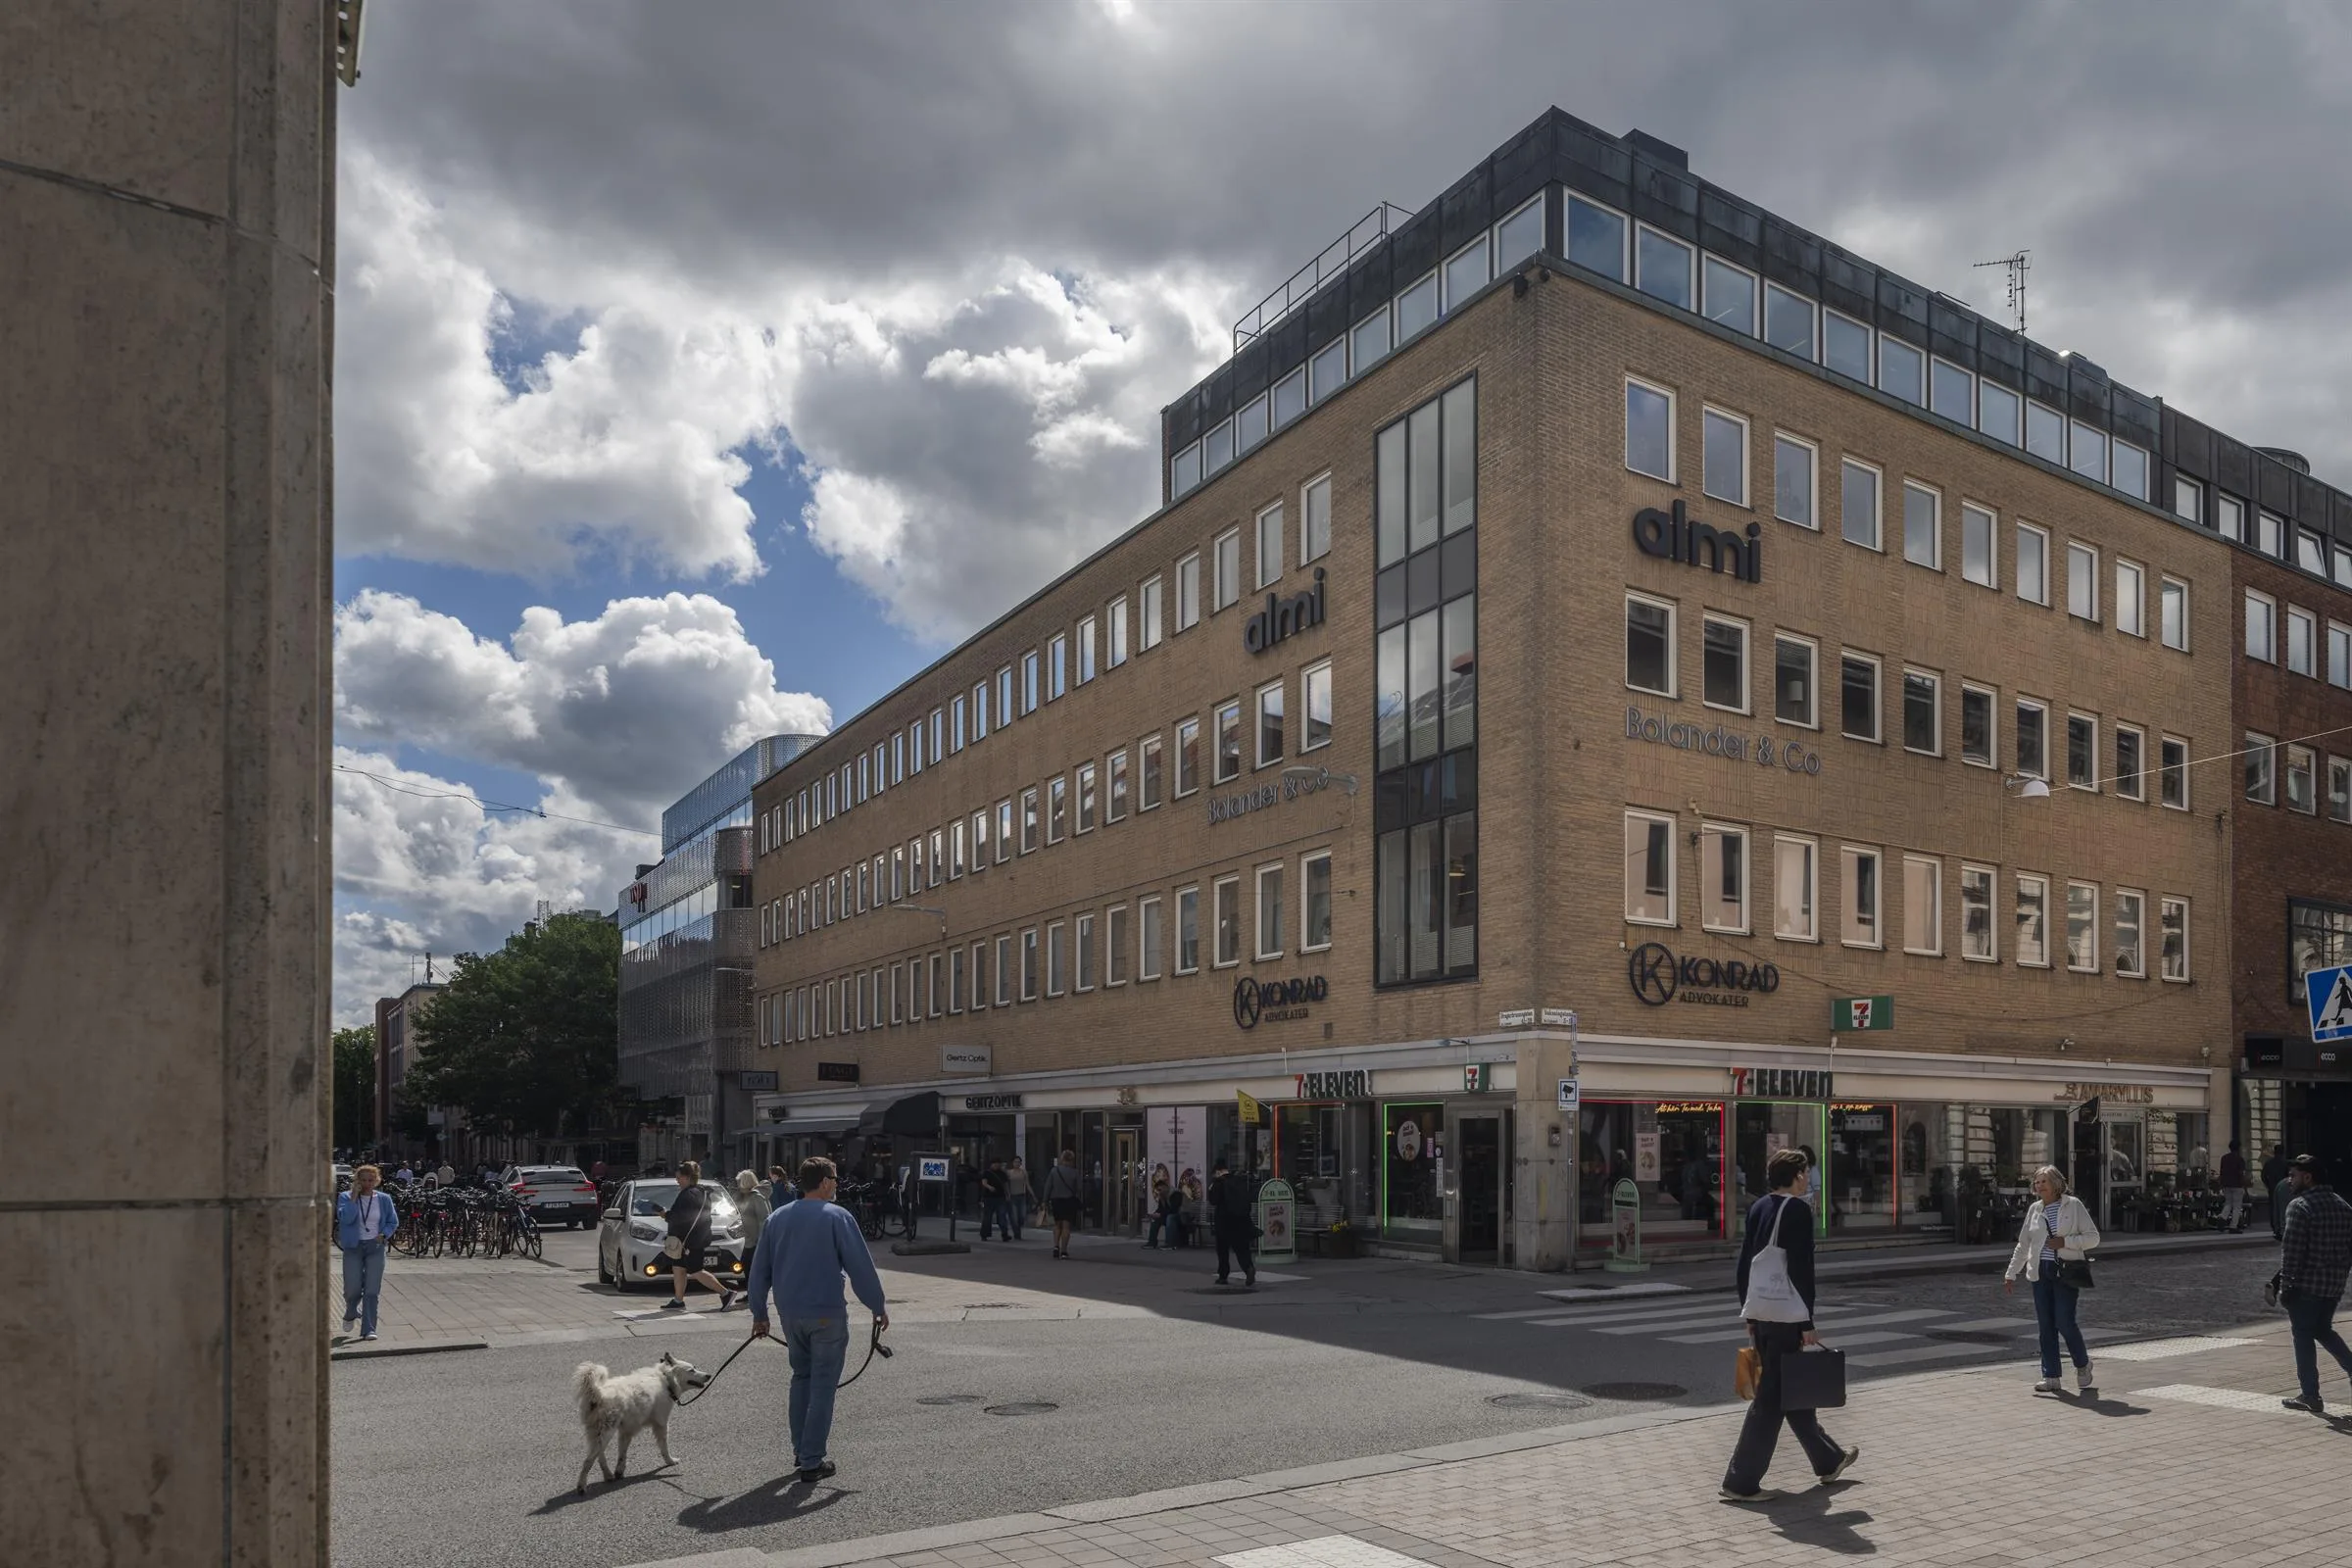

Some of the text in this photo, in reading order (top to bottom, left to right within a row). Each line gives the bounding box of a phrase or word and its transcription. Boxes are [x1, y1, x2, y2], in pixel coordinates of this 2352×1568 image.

[1634, 499, 1761, 583] almi
[1244, 566, 1327, 655] almi
[1626, 706, 1820, 775] Bolander & Co
[1207, 783, 1279, 825] Bolander
[1261, 974, 1328, 1008] KONRAD
[1681, 956, 1780, 994] KONRAD
[1264, 1007, 1309, 1022] ADVOKATER
[1680, 992, 1749, 1008] ADVOKATER
[2079, 1083, 2154, 1103] AMARYLLIS
